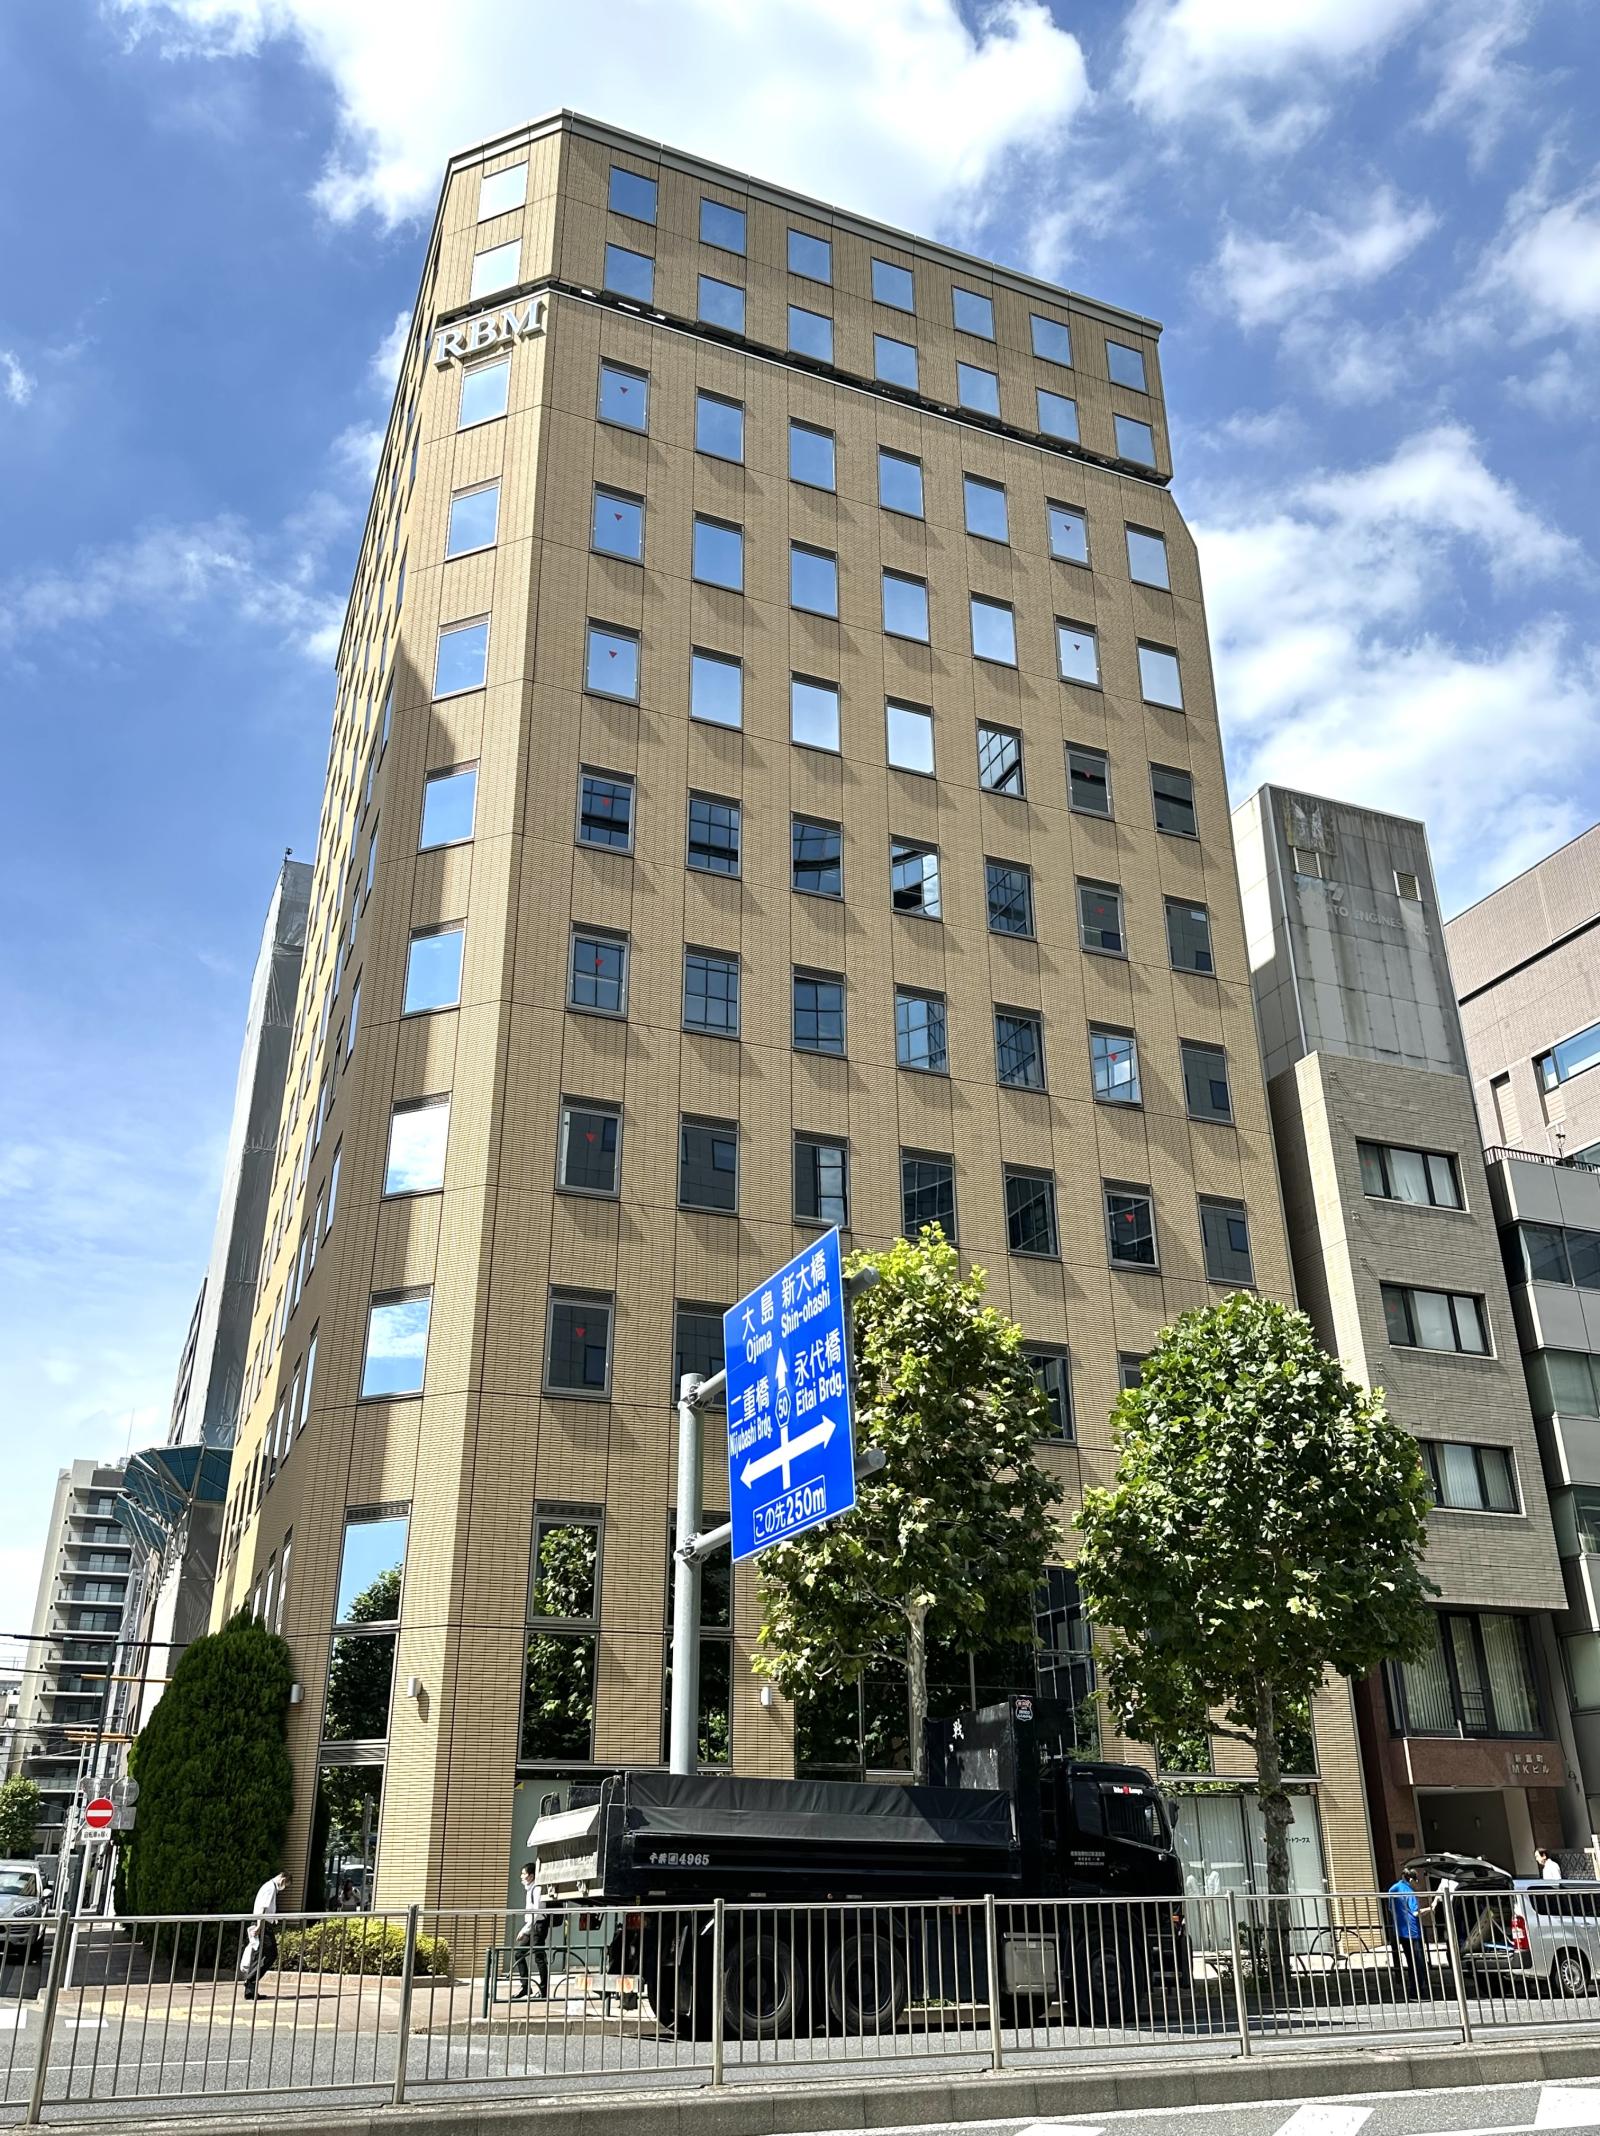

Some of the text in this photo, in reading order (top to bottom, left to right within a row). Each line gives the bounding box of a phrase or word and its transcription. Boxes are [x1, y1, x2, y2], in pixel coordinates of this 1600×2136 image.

[433, 300, 543, 366] RBM
[742, 1248, 826, 1341] 大島 新大橋
[746, 1283, 831, 1365] Ojima Shin-ohashi
[794, 1327, 842, 1388] 永代橋
[730, 1375, 770, 1430] 二重橋
[778, 1396, 789, 1419] 50
[795, 1368, 846, 1418] Eitai Brdg.
[757, 1412, 773, 1440] Brdg.
[755, 1486, 826, 1539] この先250m
